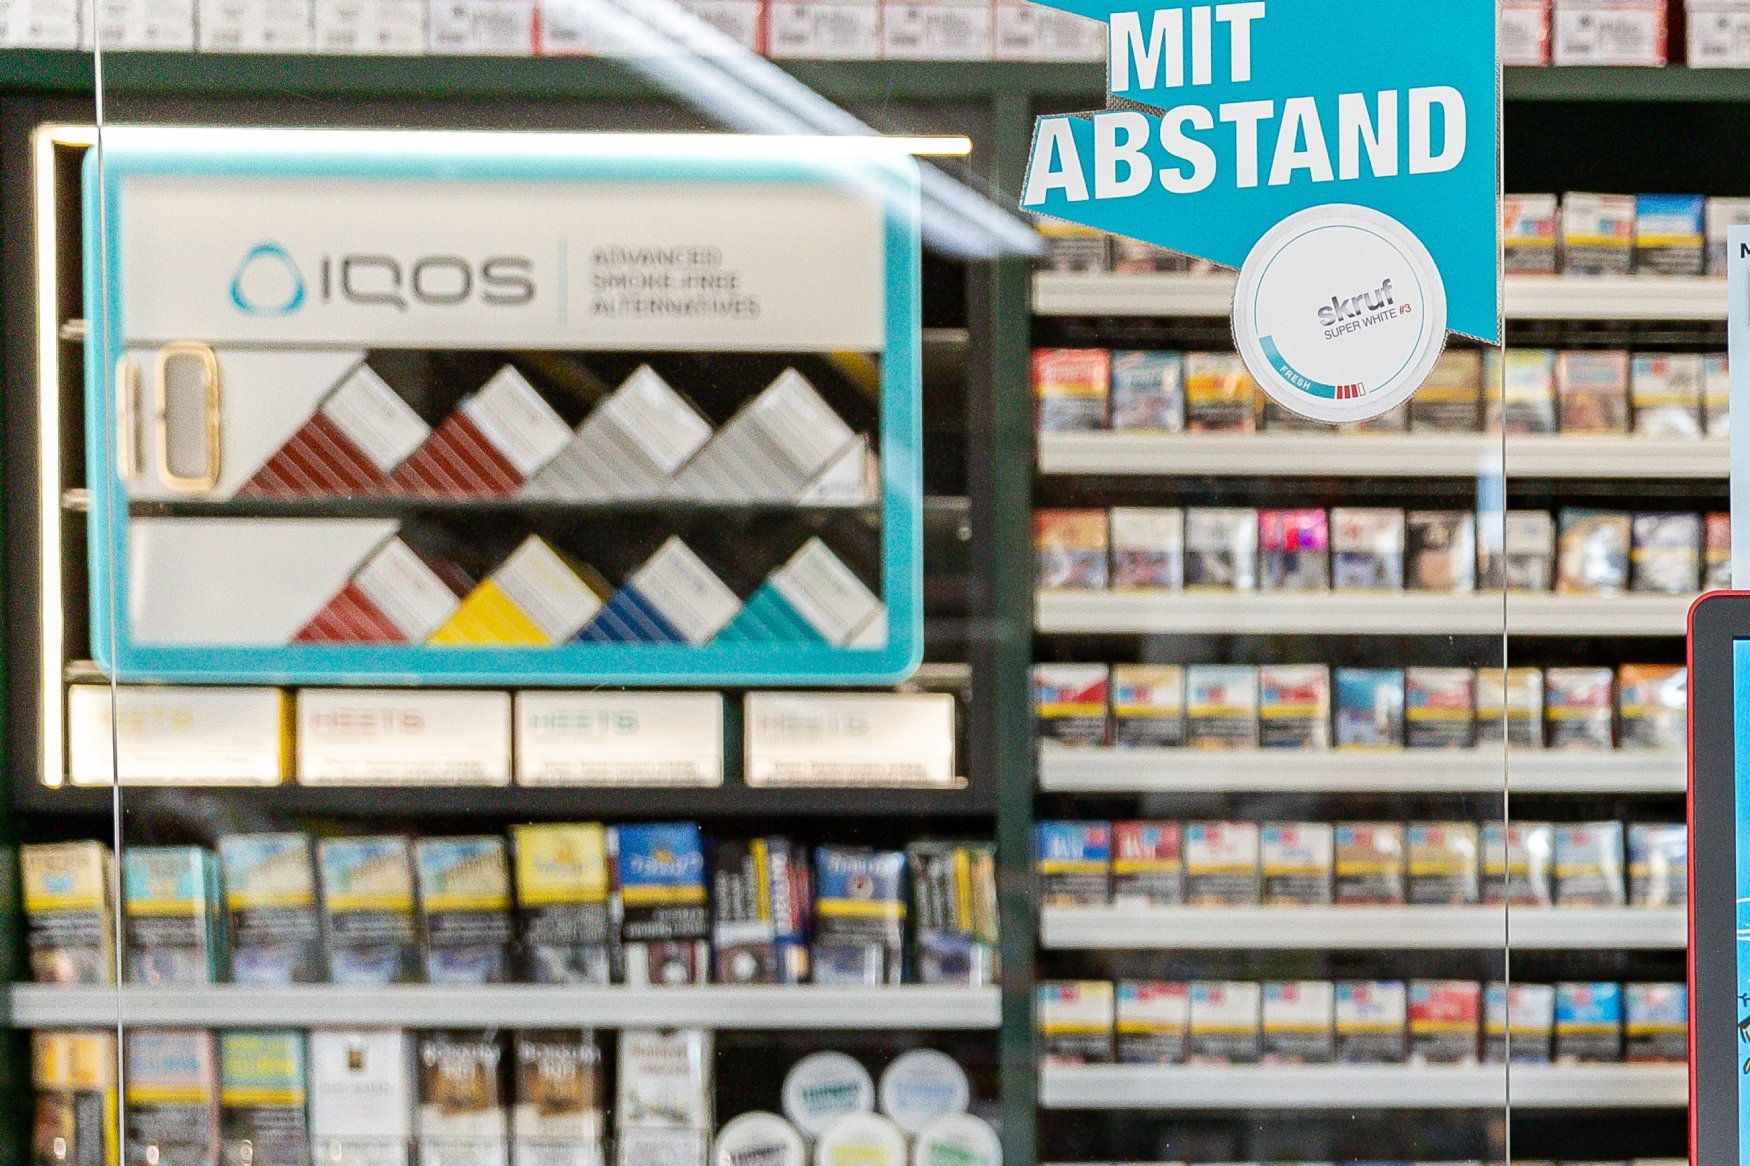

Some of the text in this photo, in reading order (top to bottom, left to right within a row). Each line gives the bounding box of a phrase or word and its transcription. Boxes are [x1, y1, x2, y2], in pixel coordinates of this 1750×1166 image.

[1110, 2, 1264, 92] MIT
[1022, 86, 1466, 205] ABSTAND
[320, 253, 537, 313] IQOS
[1317, 278, 1395, 327] skruf
[1324, 304, 1412, 340] SUPER WHITE #3
[1280, 365, 1311, 390] FRESH
